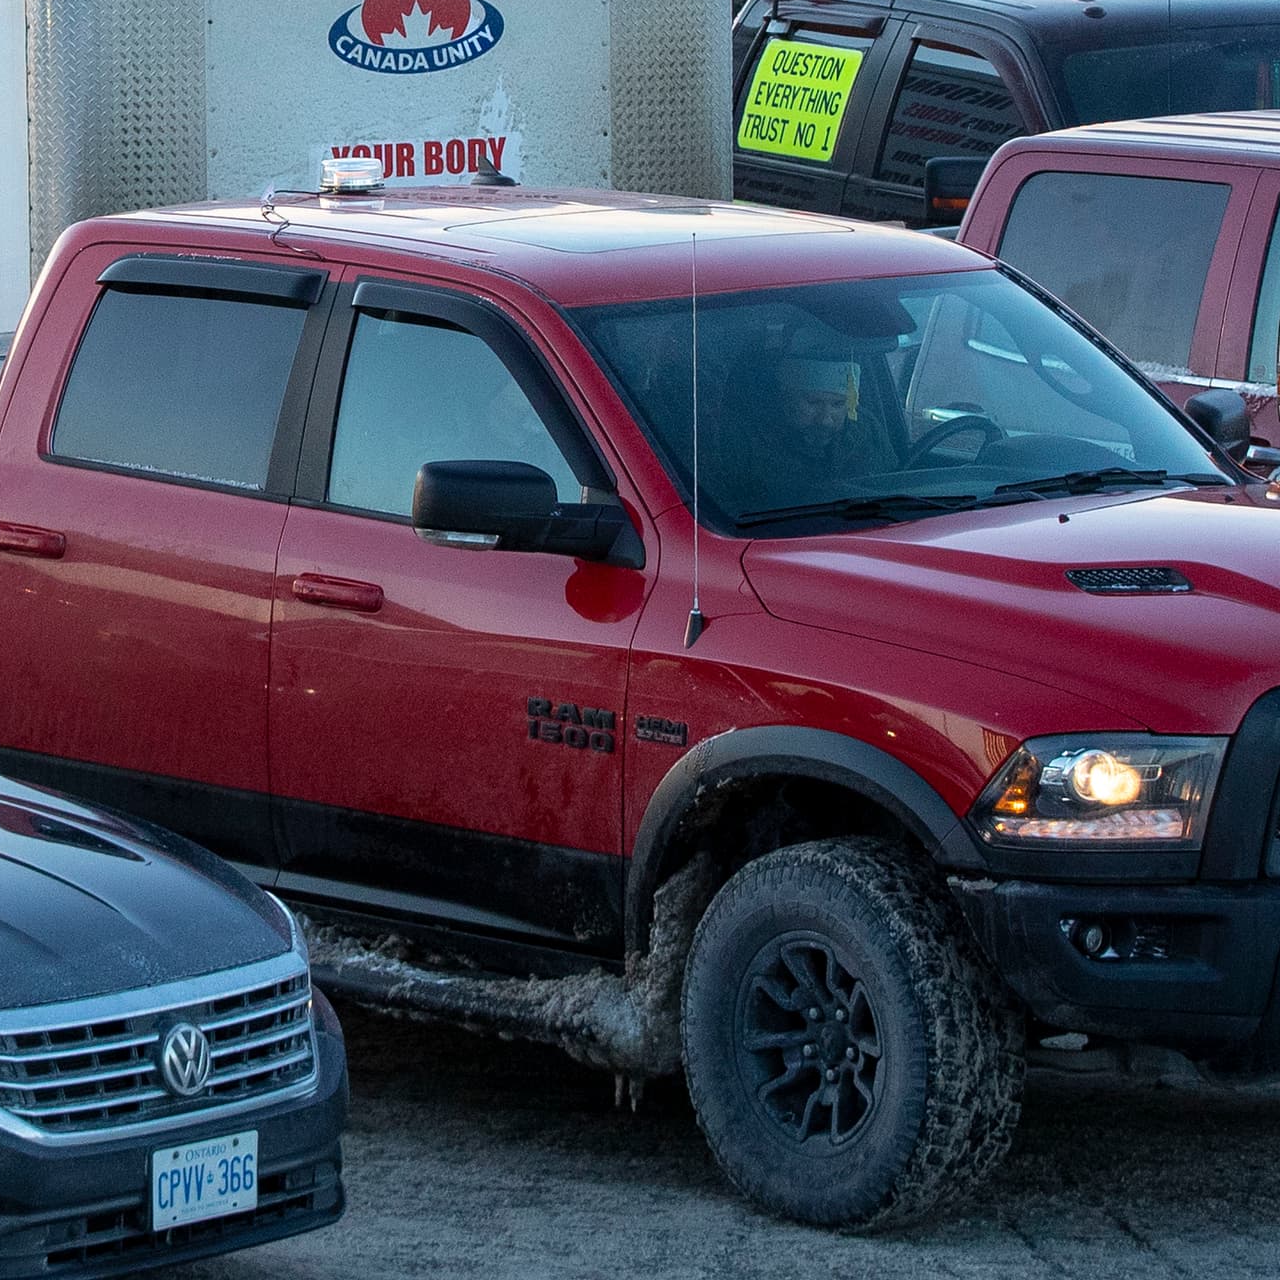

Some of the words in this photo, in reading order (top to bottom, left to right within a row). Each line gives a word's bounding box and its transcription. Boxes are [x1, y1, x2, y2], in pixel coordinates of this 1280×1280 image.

[335, 34, 430, 72] CANADA
[432, 23, 495, 67] UNITY
[772, 49, 846, 81] QUESTION
[754, 80, 842, 116] EVERYTHING
[743, 113, 790, 144] TRUST
[793, 121, 816, 149] NO
[820, 126, 832, 152] 1
[423, 136, 507, 176] BODY
[527, 695, 617, 731] RAM
[527, 720, 615, 754] 1500
[185, 1143, 227, 1162] ONTARIO
[158, 1162, 205, 1209] CPVV
[218, 1152, 254, 1196] 366
